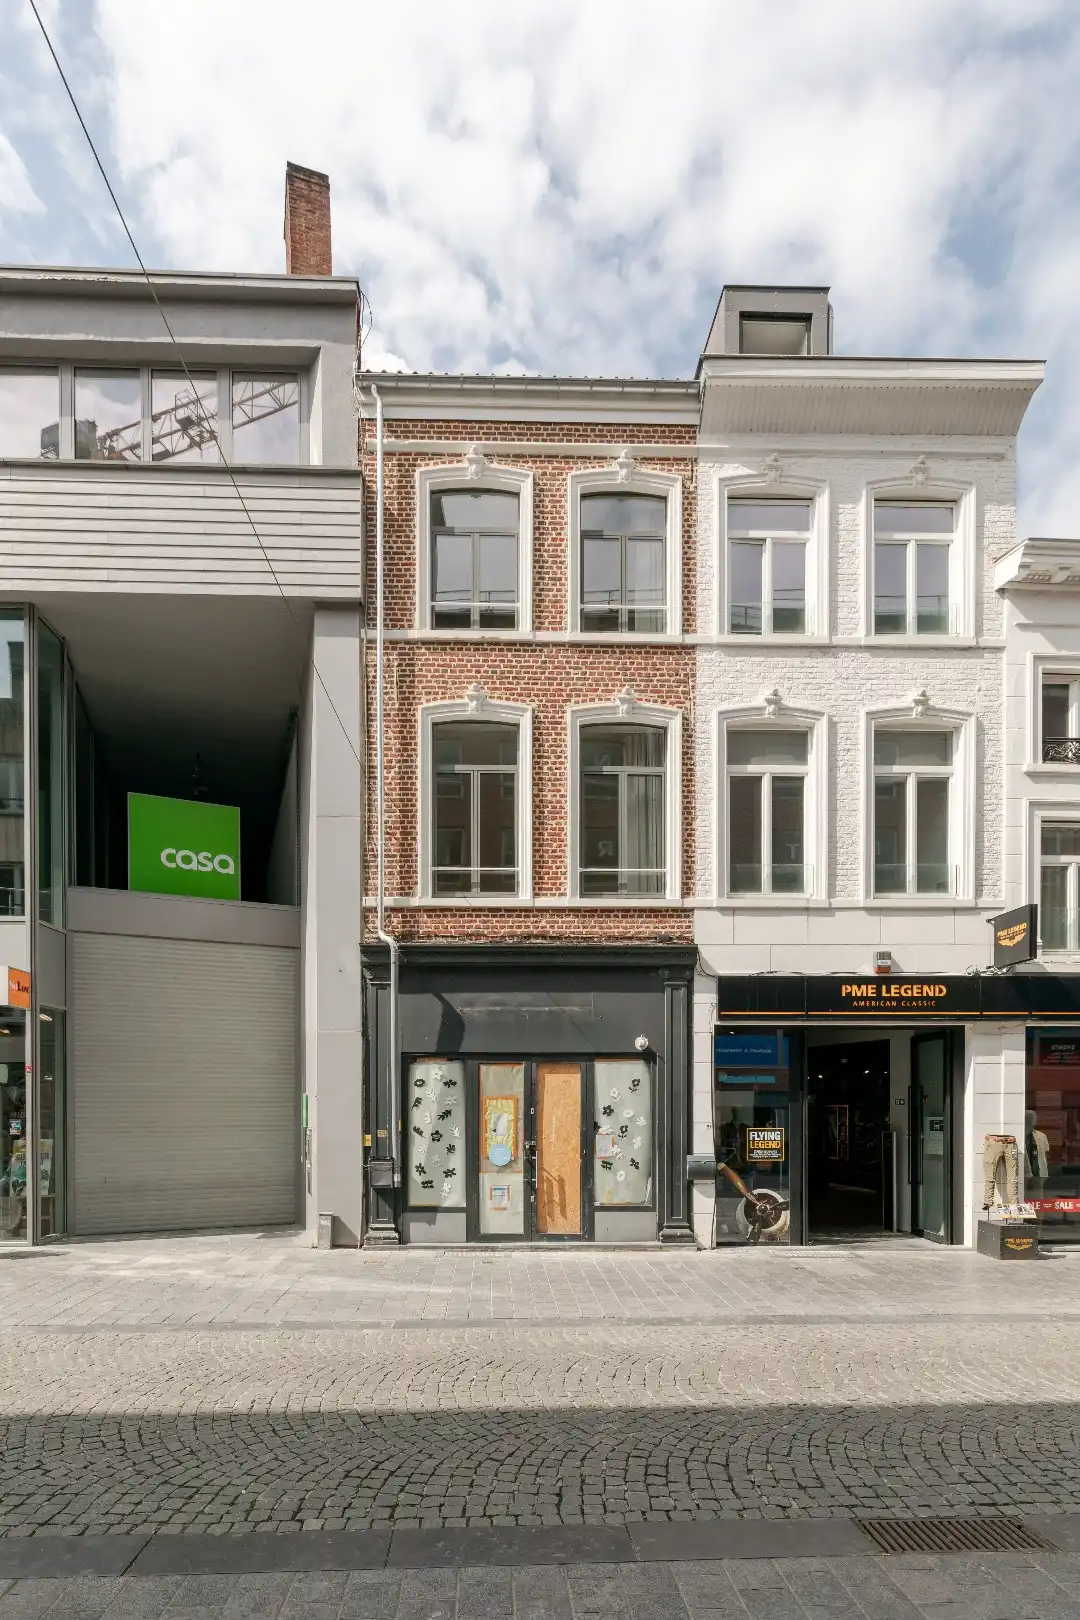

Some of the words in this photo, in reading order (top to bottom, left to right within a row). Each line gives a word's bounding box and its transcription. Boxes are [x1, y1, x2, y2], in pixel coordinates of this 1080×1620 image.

[160, 847, 235, 875] casa
[841, 984, 877, 997] PME
[881, 984, 947, 997] LEGEND
[750, 1131, 781, 1140] FLYING
[750, 1140, 780, 1148] LEGEND
[1054, 1201, 1074, 1210] SALE
